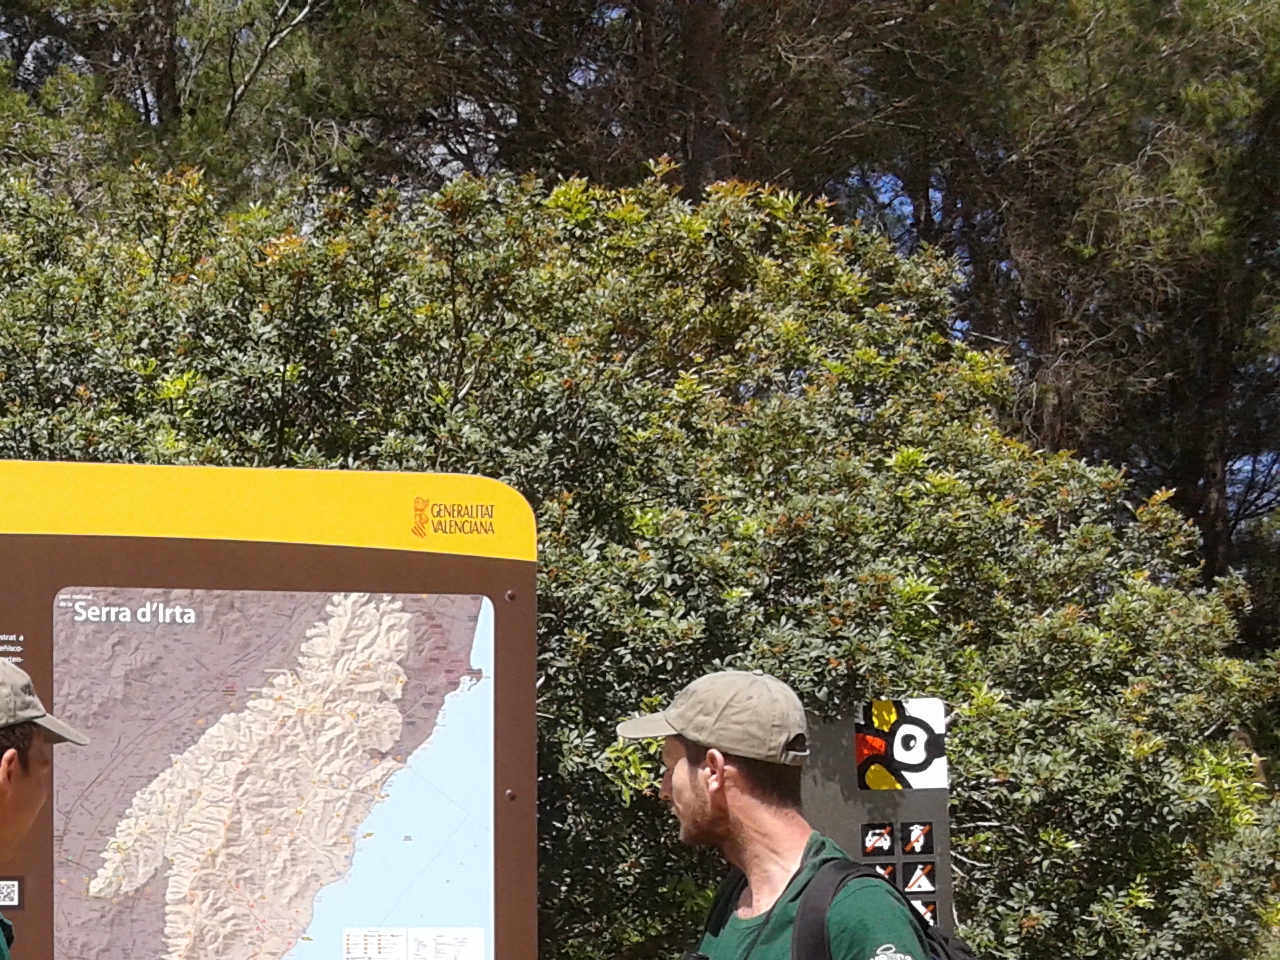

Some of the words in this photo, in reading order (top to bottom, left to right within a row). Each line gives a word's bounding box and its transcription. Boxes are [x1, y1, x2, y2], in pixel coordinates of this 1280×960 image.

[431, 503, 494, 519] GENERALITAT
[431, 520, 494, 534] VALENCIANA
[74, 601, 132, 622] Serra
[136, 601, 196, 624] d'Irta
